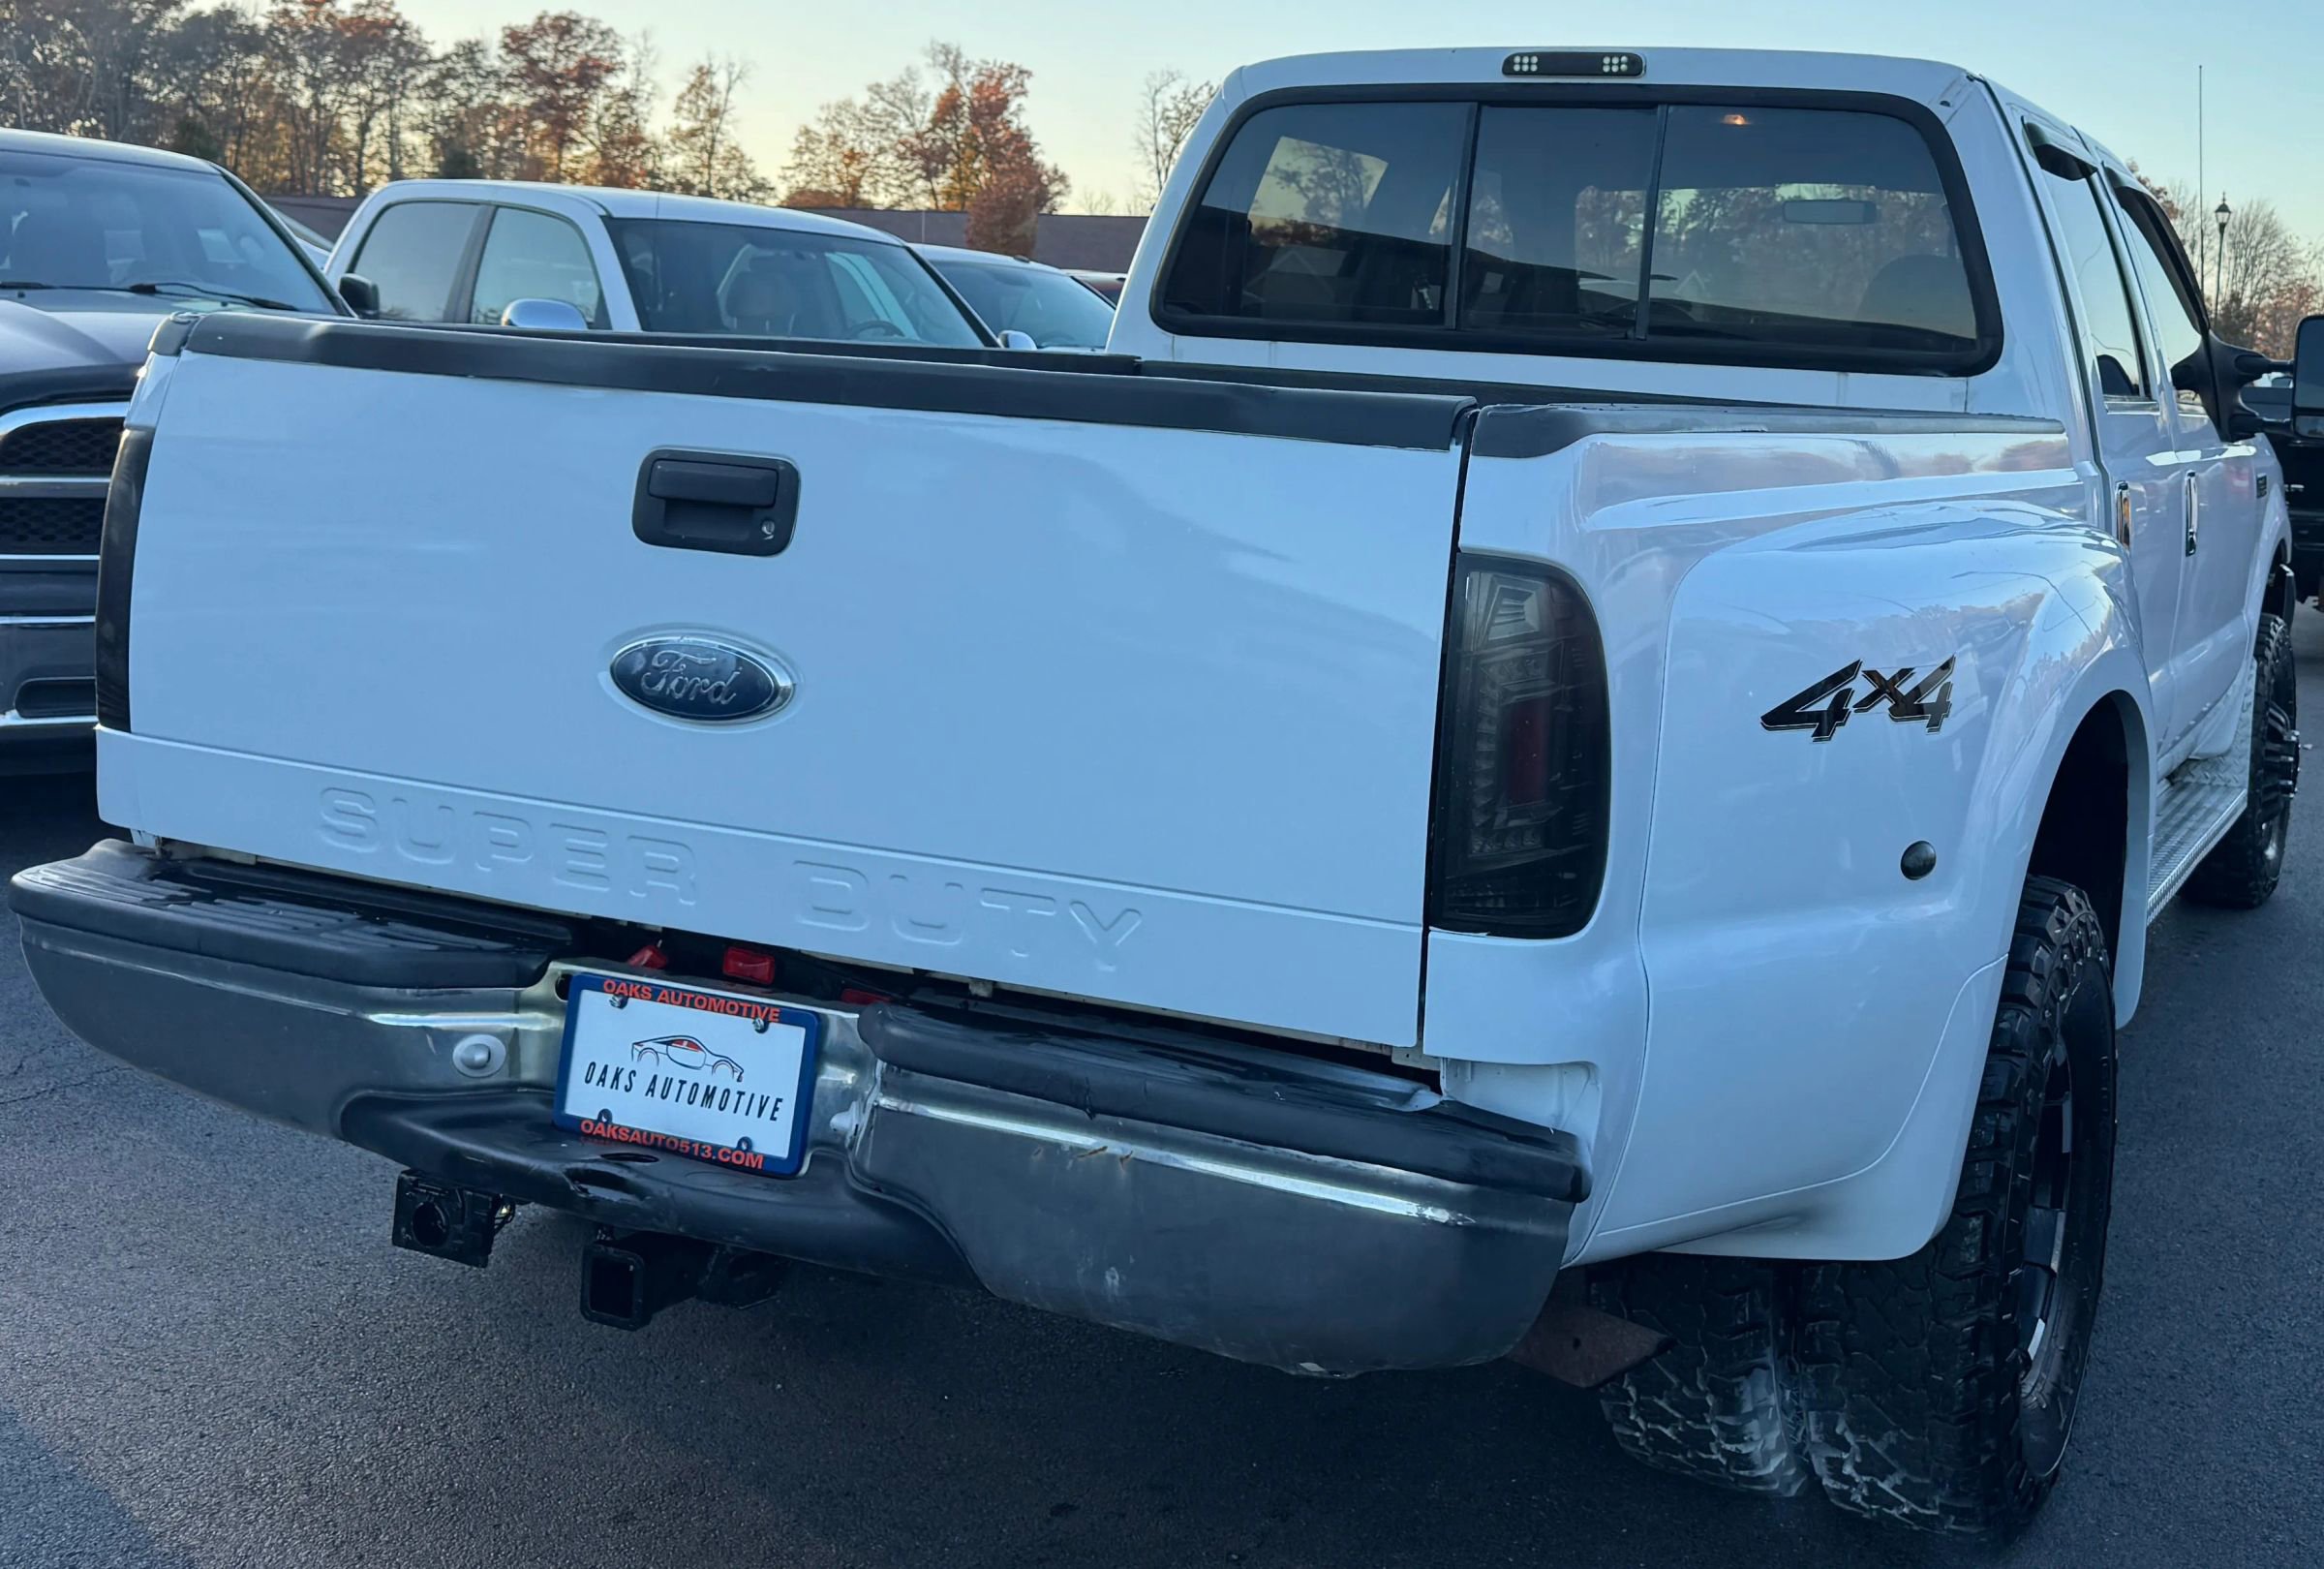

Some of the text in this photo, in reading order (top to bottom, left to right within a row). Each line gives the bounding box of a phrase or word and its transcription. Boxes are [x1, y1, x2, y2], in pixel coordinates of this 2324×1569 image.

[640, 649, 743, 705] Ford
[1760, 655, 1956, 743] 4x4
[319, 786, 1143, 972] SUPER DUTY
[602, 978, 780, 1023] OAKS AUTOMOTIVE
[584, 1061, 783, 1122] OAKS AUTOMOTIVE
[580, 1119, 765, 1170] OAKSAUTO513.COM
